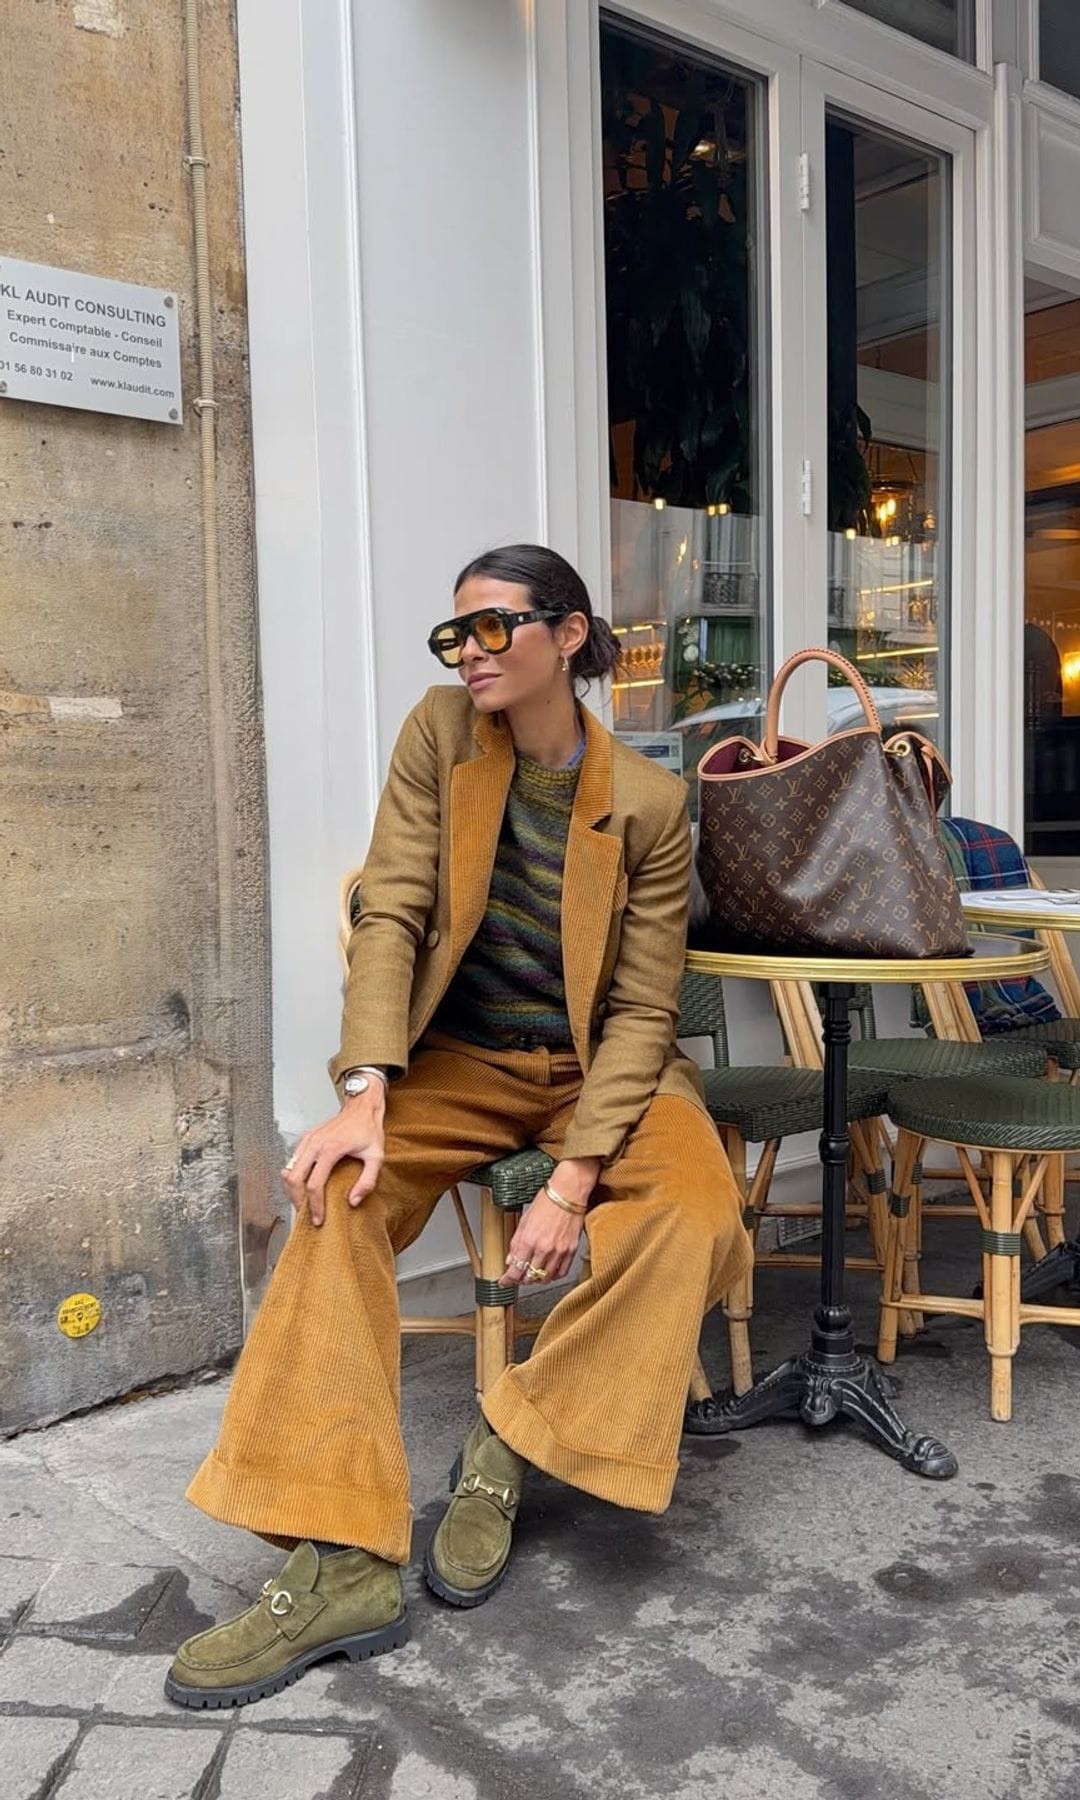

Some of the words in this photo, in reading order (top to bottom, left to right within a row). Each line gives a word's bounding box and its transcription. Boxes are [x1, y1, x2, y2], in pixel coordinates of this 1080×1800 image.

[25, 289, 70, 309] AUDIT
[74, 299, 166, 328] CONSULTING
[7, 309, 46, 327] Expert
[49, 317, 111, 339] Comptable
[121, 331, 162, 348] Conseil
[89, 348, 110, 359] aux
[113, 350, 161, 368] Comptes
[14, 362, 27, 373] 56
[30, 365, 43, 376] 80
[45, 368, 57, 378] 31
[60, 370, 73, 381] 02
[90, 377, 175, 399] www.klaudit.com
